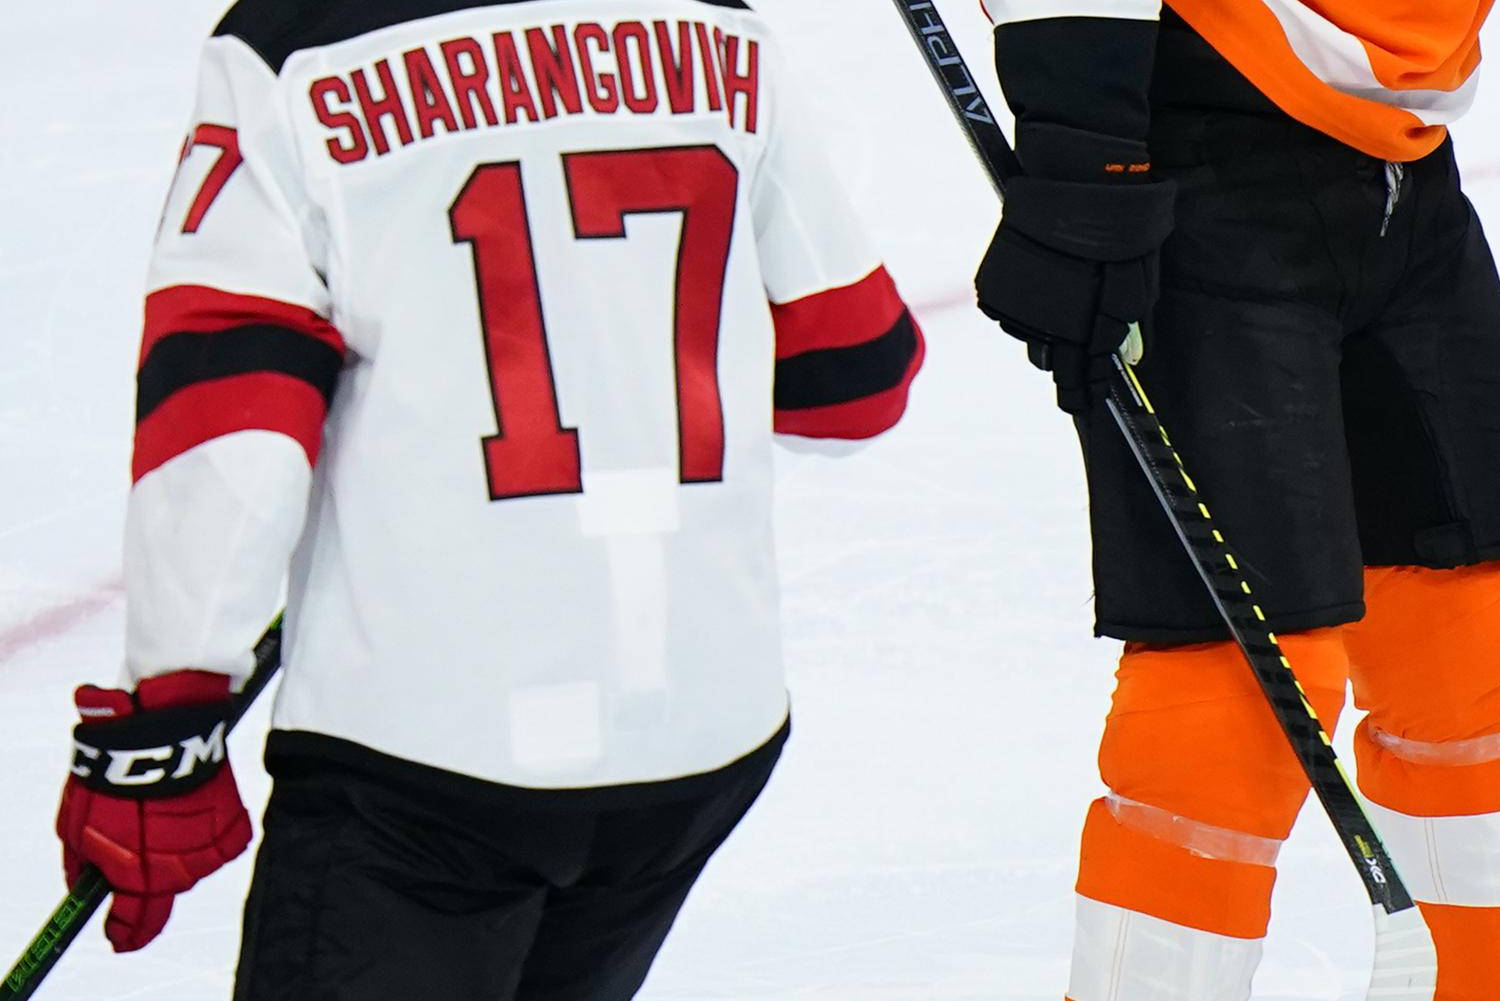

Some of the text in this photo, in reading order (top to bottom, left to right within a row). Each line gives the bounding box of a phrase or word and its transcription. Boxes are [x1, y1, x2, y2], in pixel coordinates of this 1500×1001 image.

[176, 123, 244, 235] 7
[447, 143, 739, 502] 17
[70, 720, 227, 786] CCM
